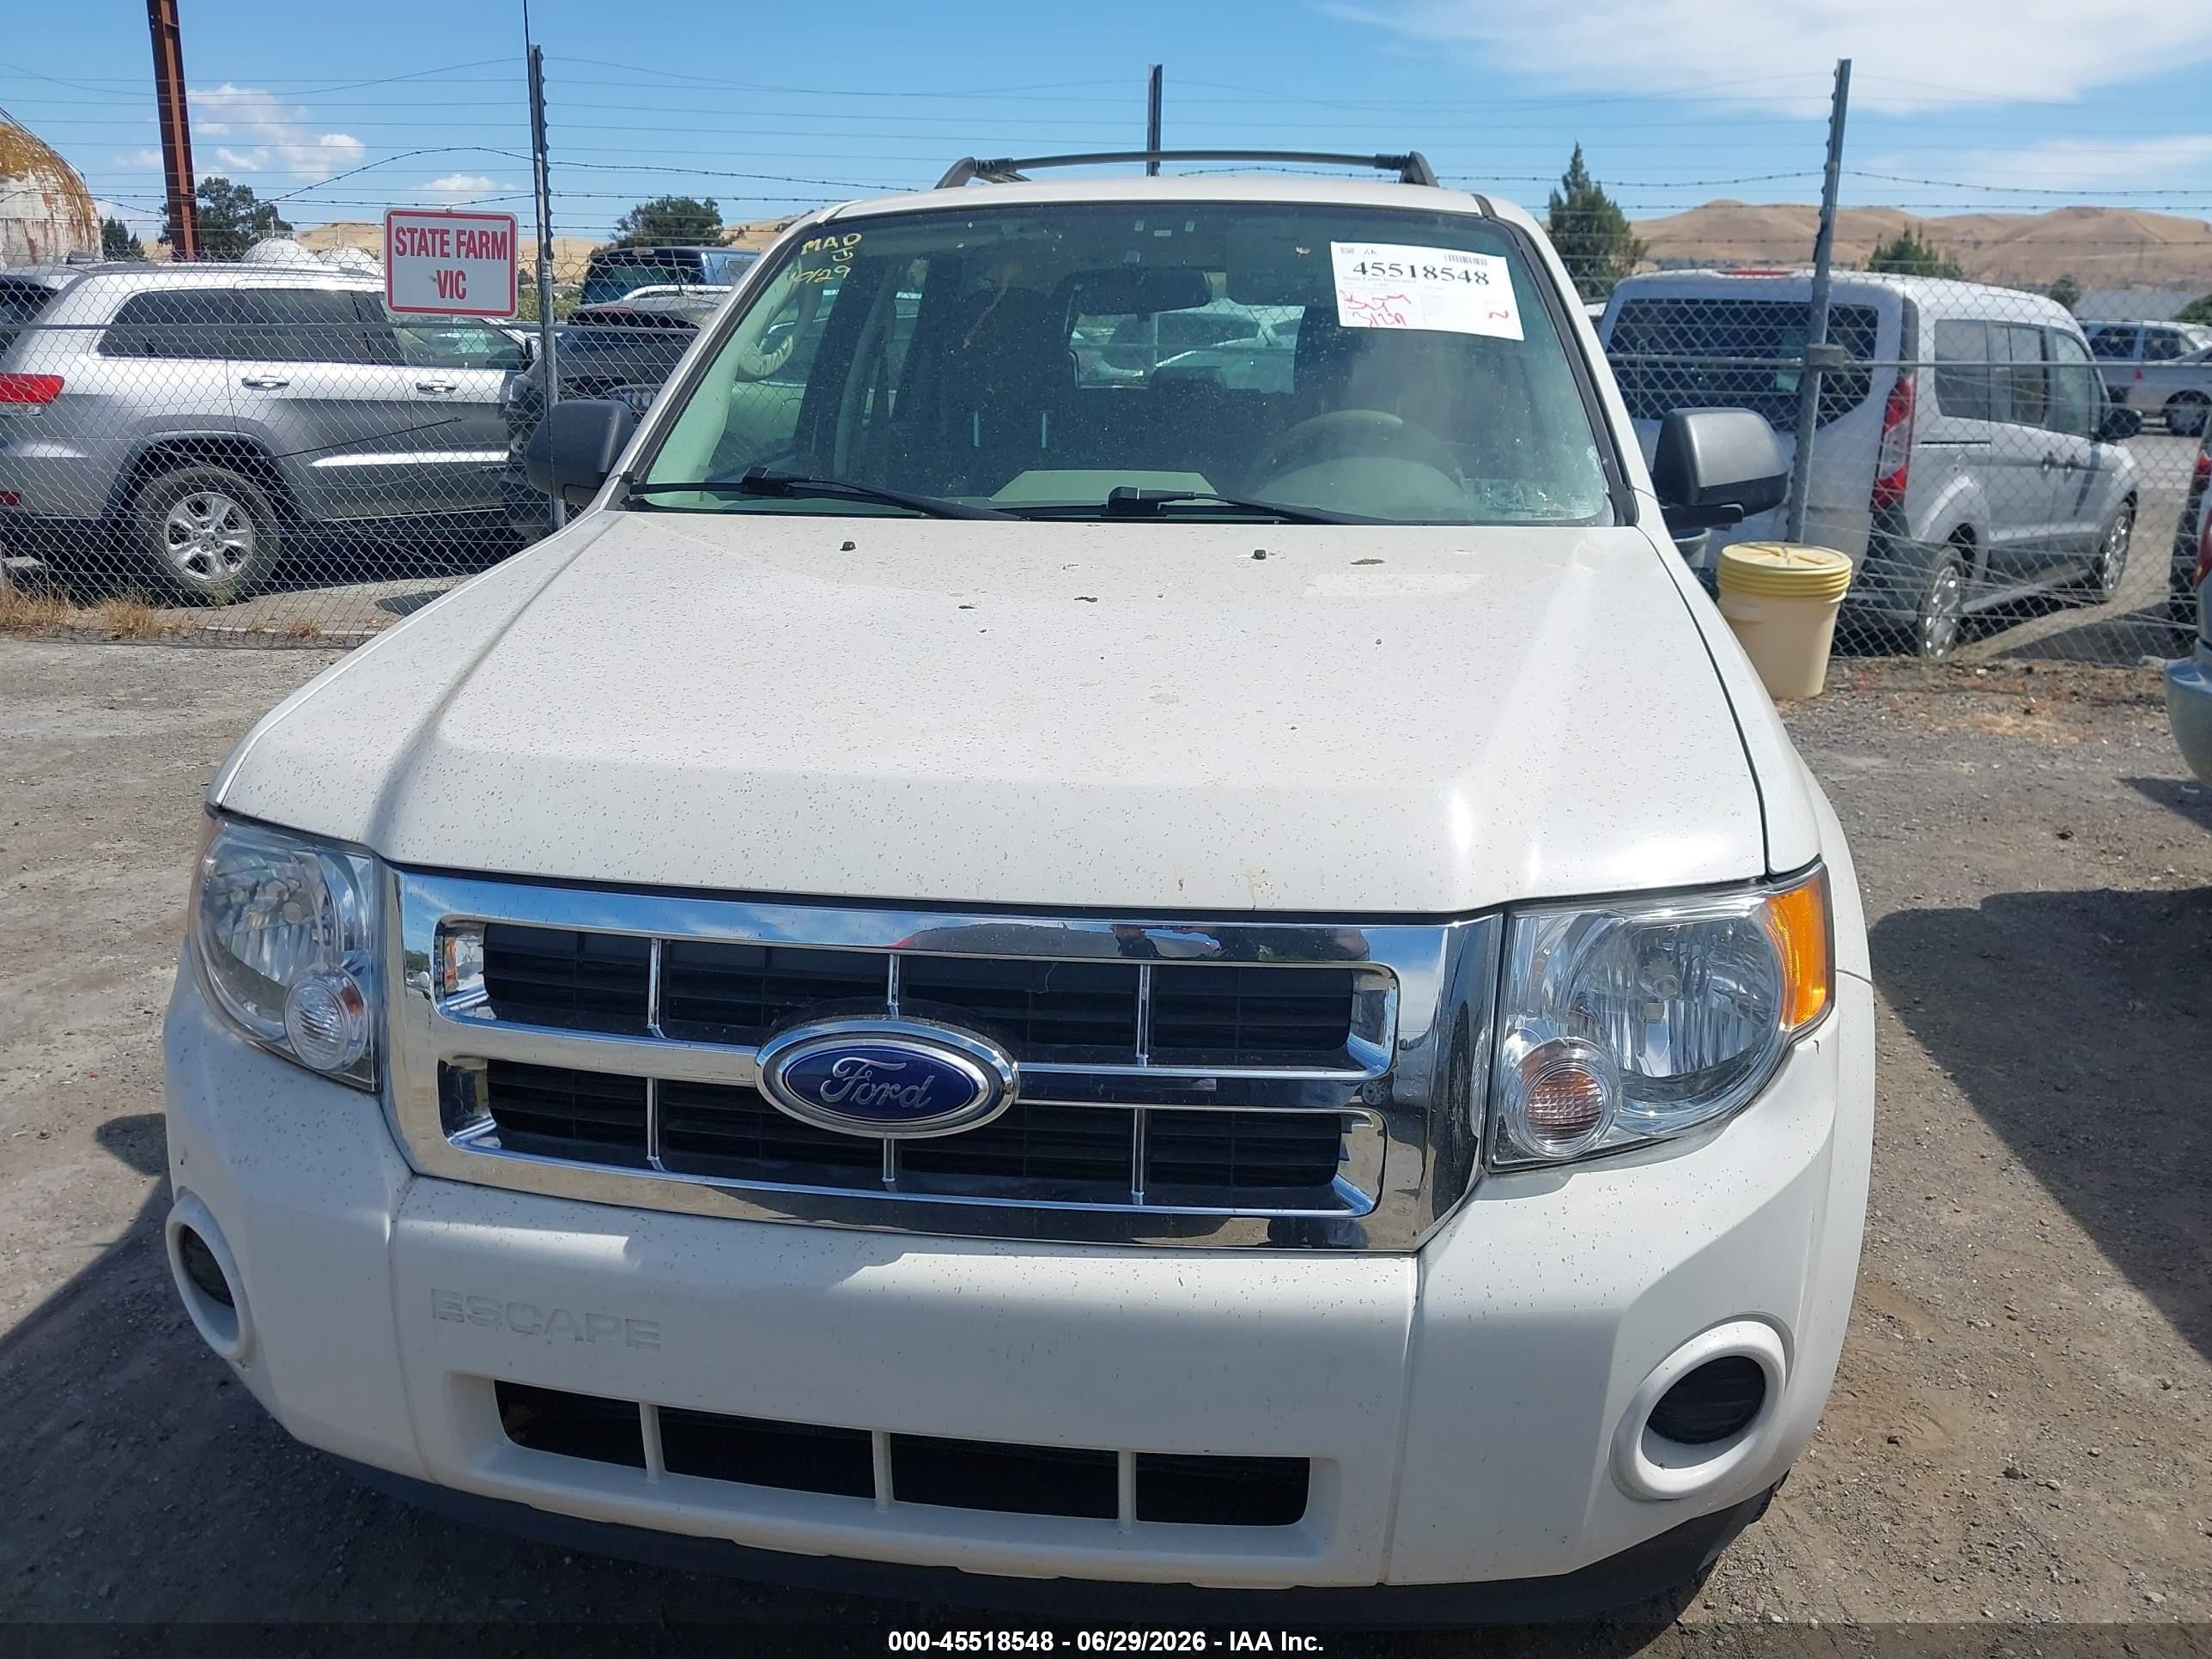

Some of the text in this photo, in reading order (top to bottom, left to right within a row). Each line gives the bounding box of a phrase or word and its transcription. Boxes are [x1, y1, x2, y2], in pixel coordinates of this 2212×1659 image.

[395, 227, 507, 260] STATE FARM
[436, 270, 467, 300] VIC
[1352, 261, 1490, 286] 45518548
[820, 1056, 935, 1109] Ford
[431, 1288, 660, 1352] ESCAPE
